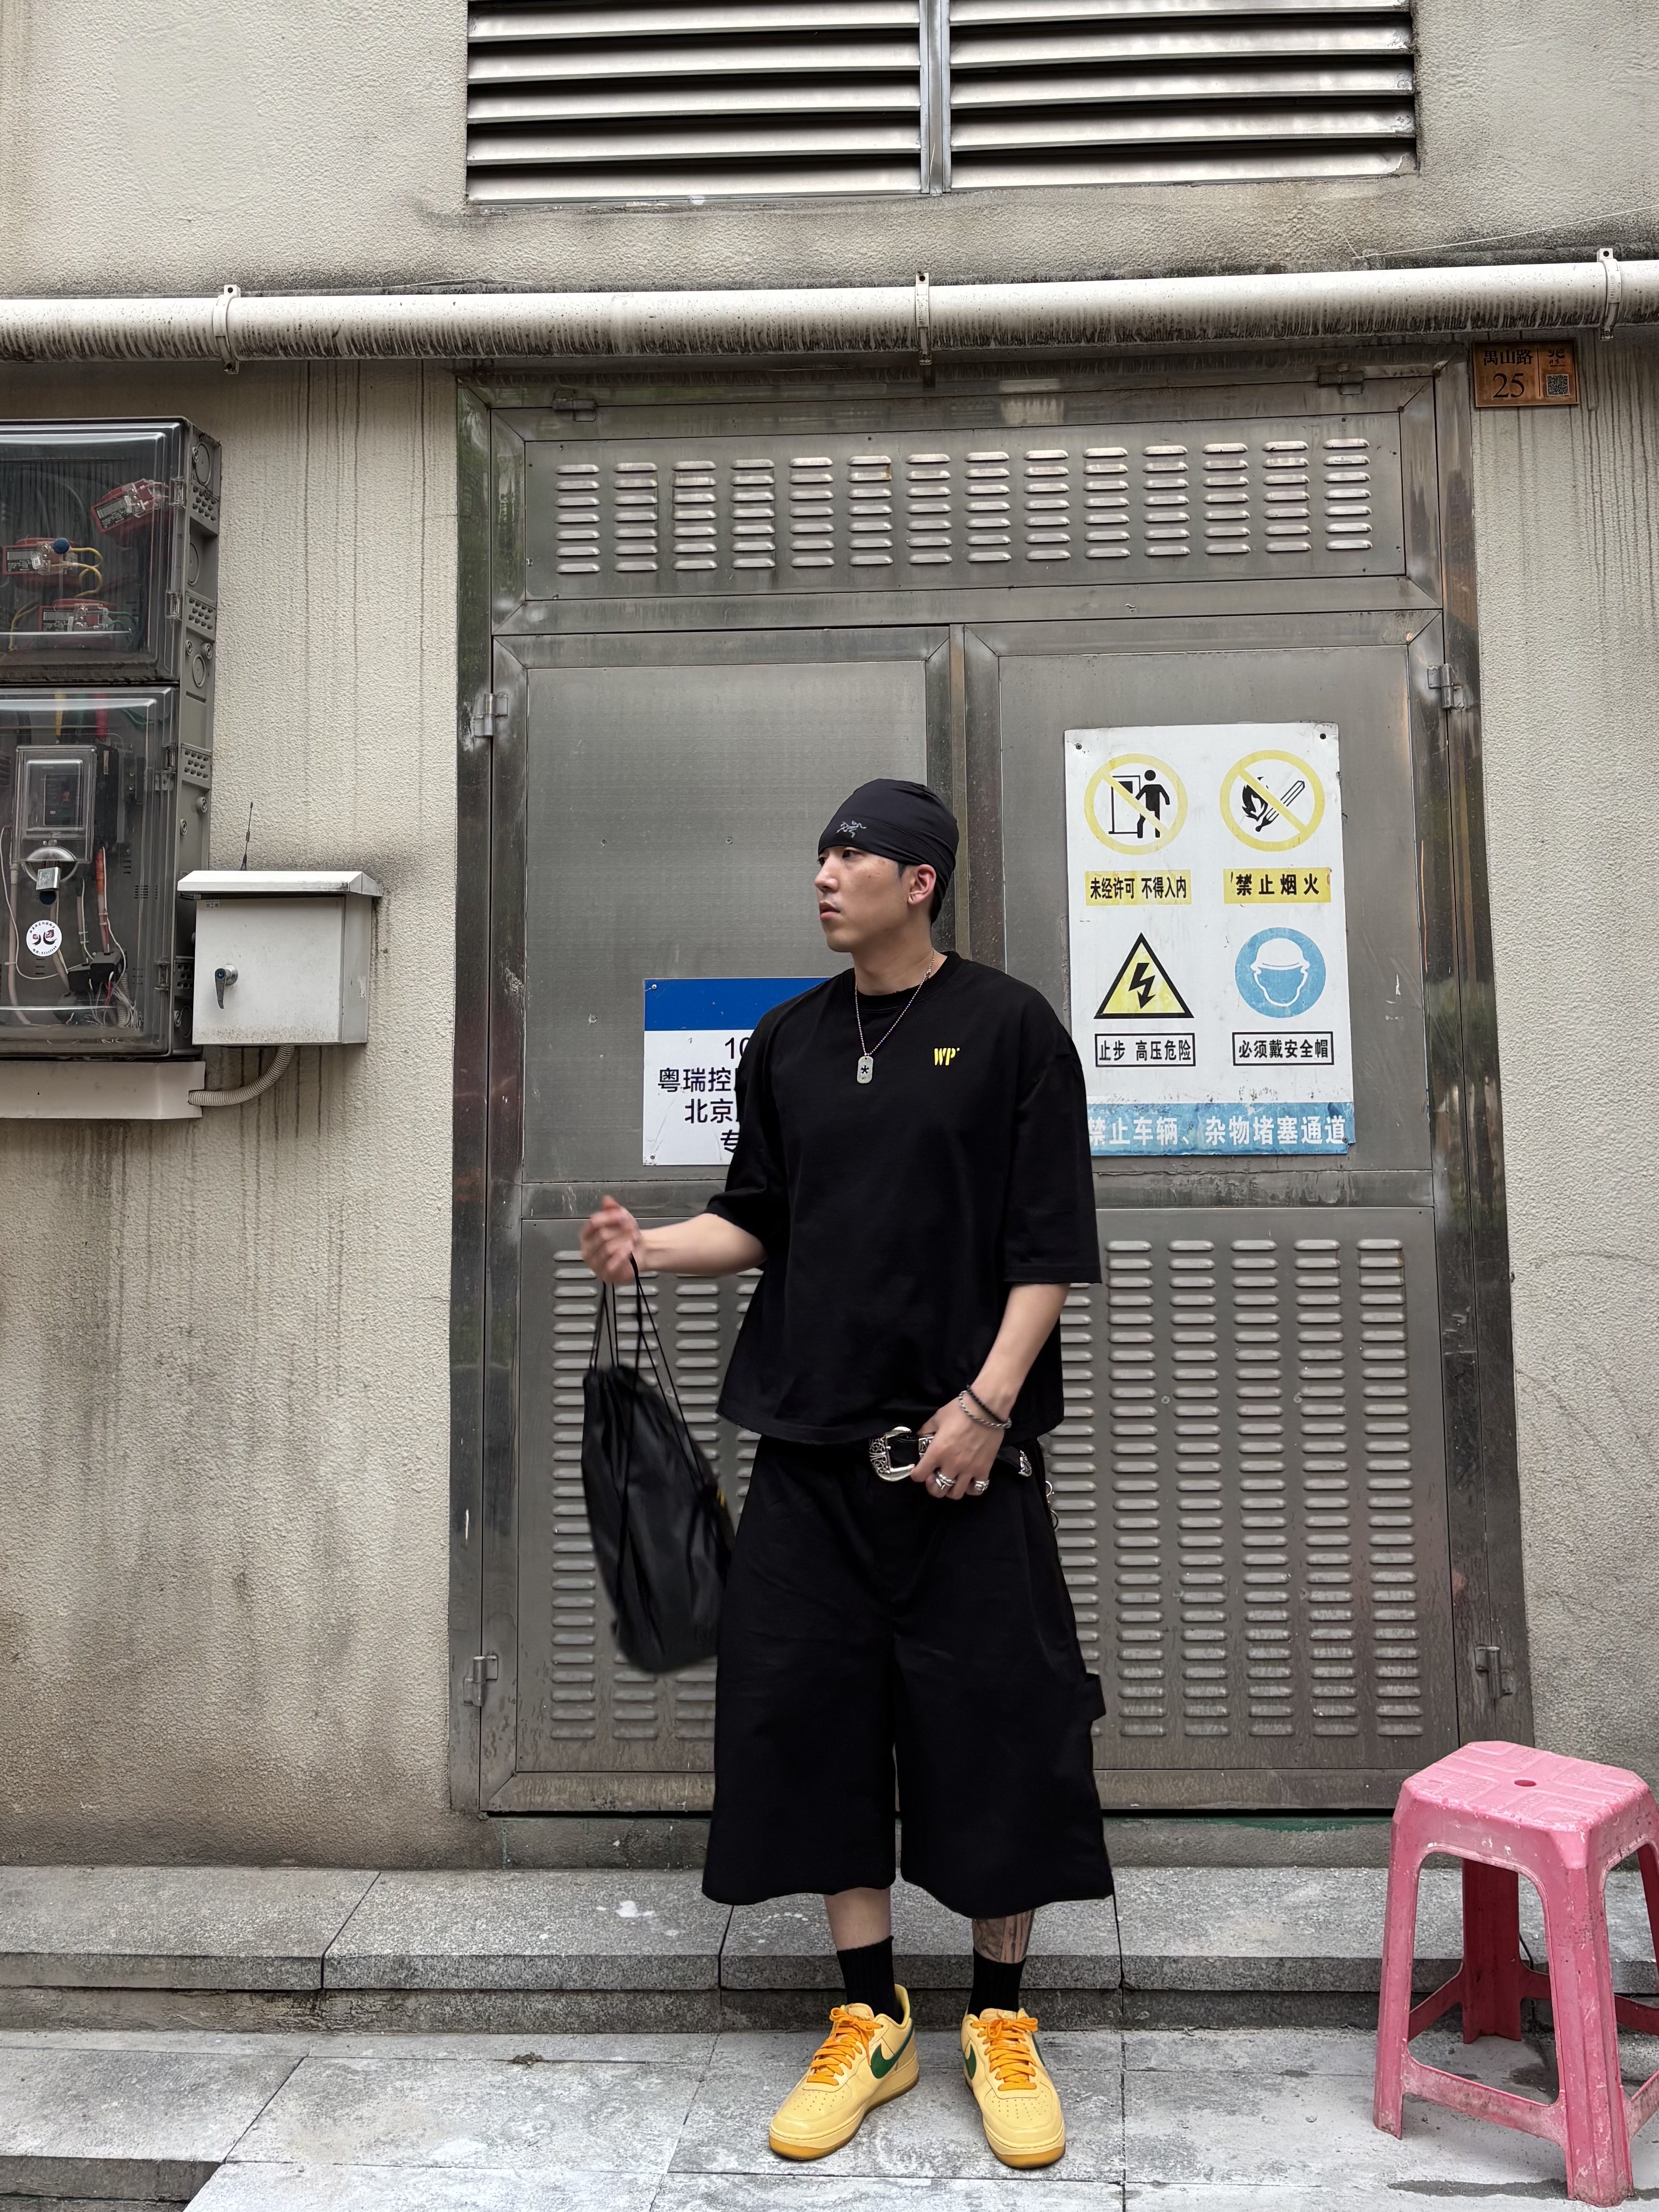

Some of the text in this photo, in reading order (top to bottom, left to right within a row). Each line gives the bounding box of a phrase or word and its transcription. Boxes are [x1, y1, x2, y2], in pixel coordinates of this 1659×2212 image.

[1483, 349, 1533, 366] 禺山路
[1492, 372, 1525, 398] 25
[1090, 876, 1186, 900] 未经许可 不得入内
[1236, 873, 1319, 896] 禁止烟火
[1098, 1039, 1192, 1062] 止步 高压危险
[1238, 1038, 1329, 1059] 必须戴安全帽
[657, 1067, 738, 1093] 粤瑞控
[684, 1098, 739, 1124] 北京
